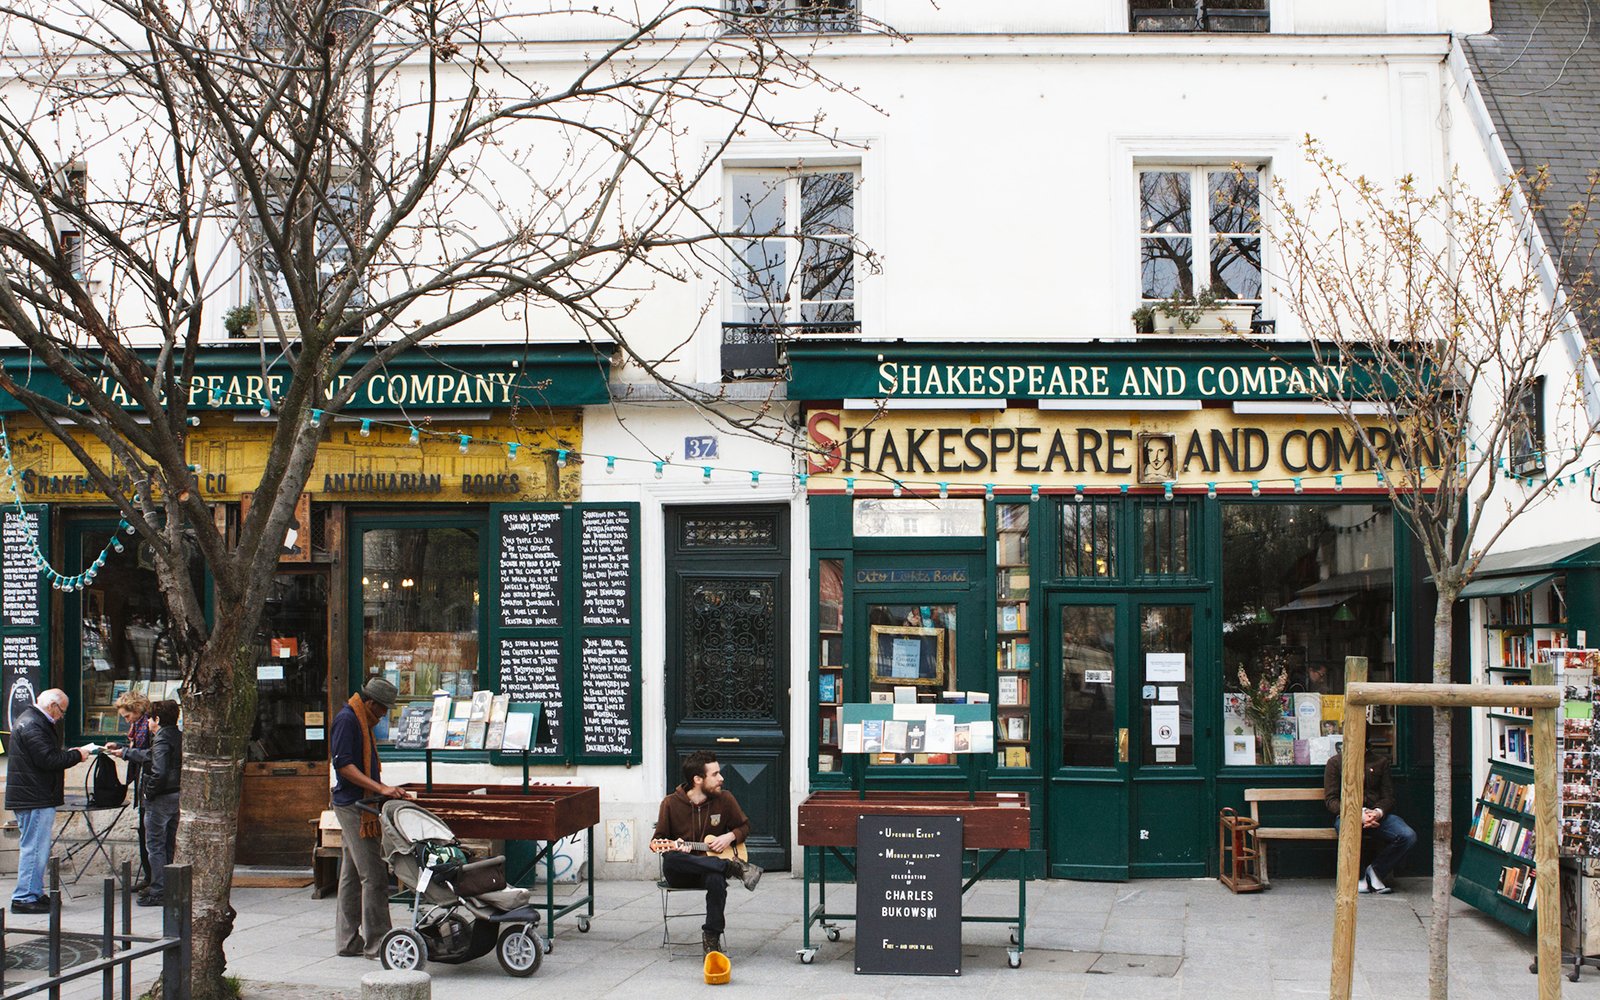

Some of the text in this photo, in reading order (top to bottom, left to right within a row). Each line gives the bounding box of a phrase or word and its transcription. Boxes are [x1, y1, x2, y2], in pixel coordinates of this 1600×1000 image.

[879, 362, 1350, 396] SHAKESPEARE AND COMPANY
[367, 373, 516, 405] COMPANY
[689, 439, 713, 459] 37
[806, 411, 1458, 475] SHAKESPEARE AND COMPAN
[205, 474, 228, 493] CO
[323, 473, 442, 494] ANTIQUARIAN
[461, 473, 520, 494] BOOKS
[616, 598, 625, 608] BY
[589, 606, 595, 614] A
[584, 717, 588, 725] I
[584, 734, 597, 743] NOW
[599, 735, 605, 743] IT
[618, 735, 626, 746] MY
[885, 890, 934, 901] CHARLES
[881, 906, 938, 919] BUKOWSKI
